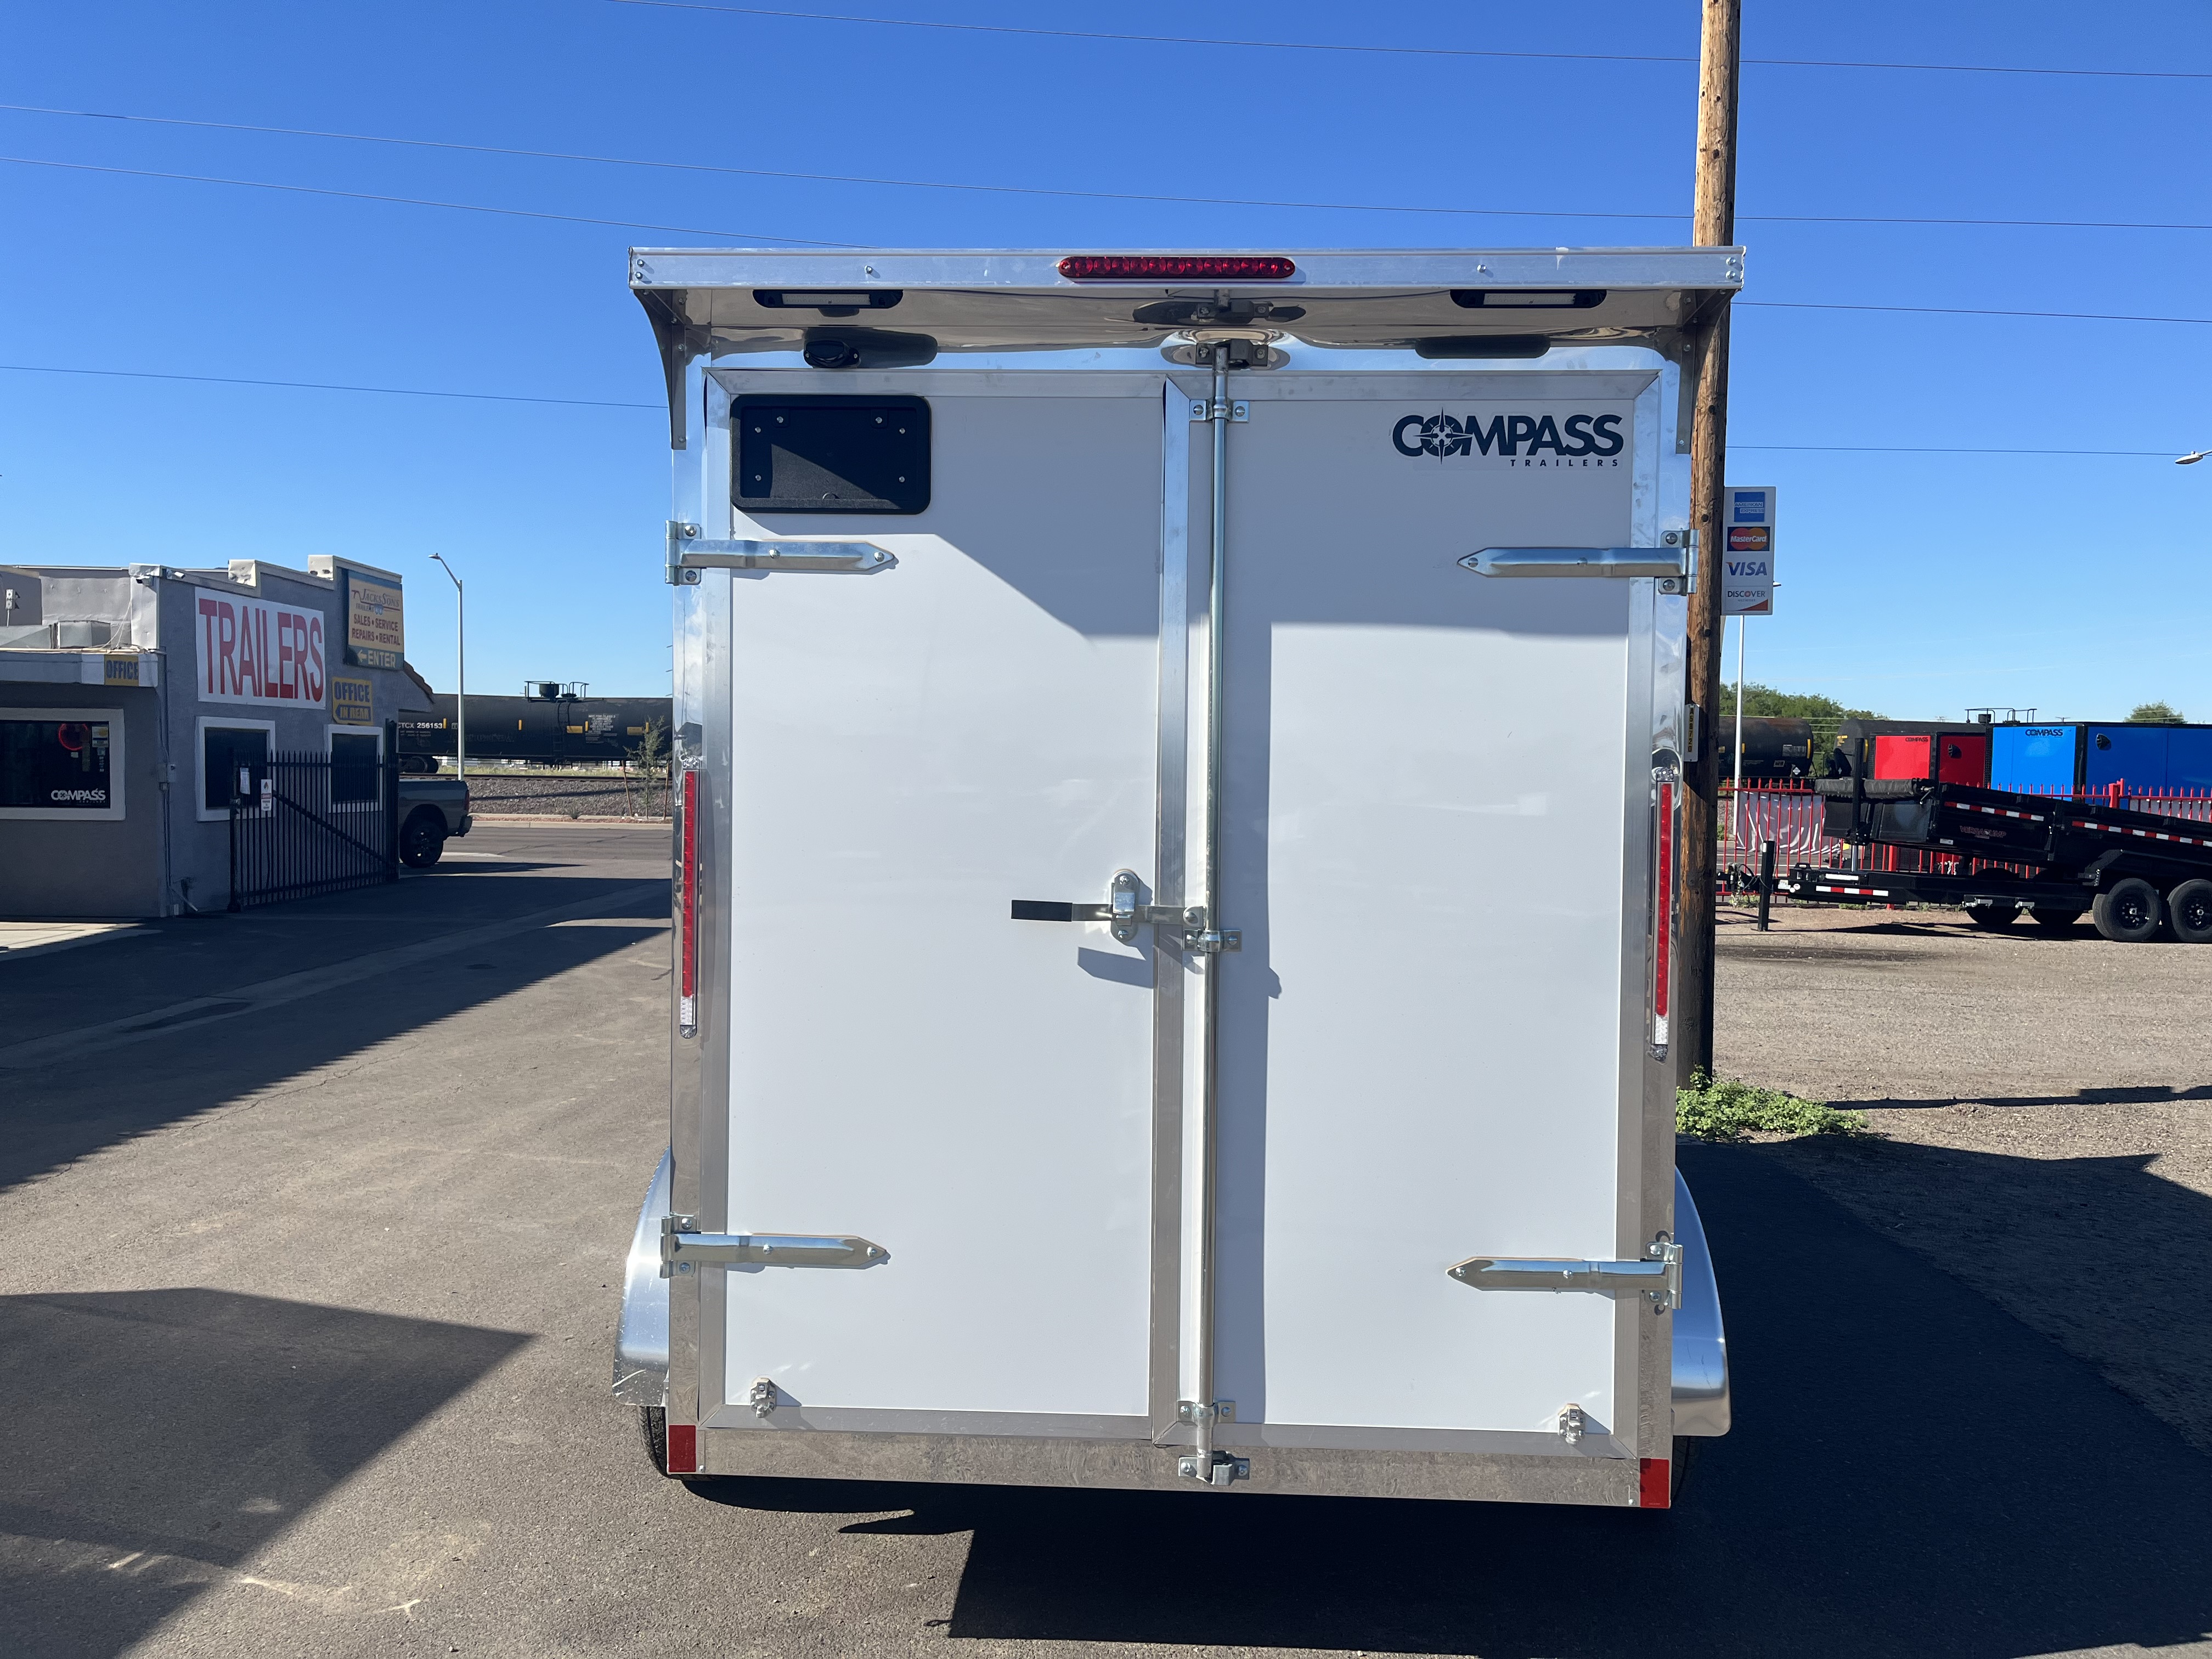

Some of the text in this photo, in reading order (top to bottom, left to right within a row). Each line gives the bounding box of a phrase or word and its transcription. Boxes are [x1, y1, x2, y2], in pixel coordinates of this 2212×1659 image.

[1392, 414, 1624, 457] COMPASS
[1725, 562, 1767, 575] VISA
[354, 613, 398, 631] SALES SERVICE
[352, 628, 400, 646] REPAIRS RENTAL
[199, 598, 324, 702] TRAILERS
[368, 650, 396, 668] ENTER
[106, 660, 138, 680] OFFICE
[334, 681, 370, 702] OFFICE
[340, 706, 348, 718] IN
[51, 789, 106, 800] COMPASS
